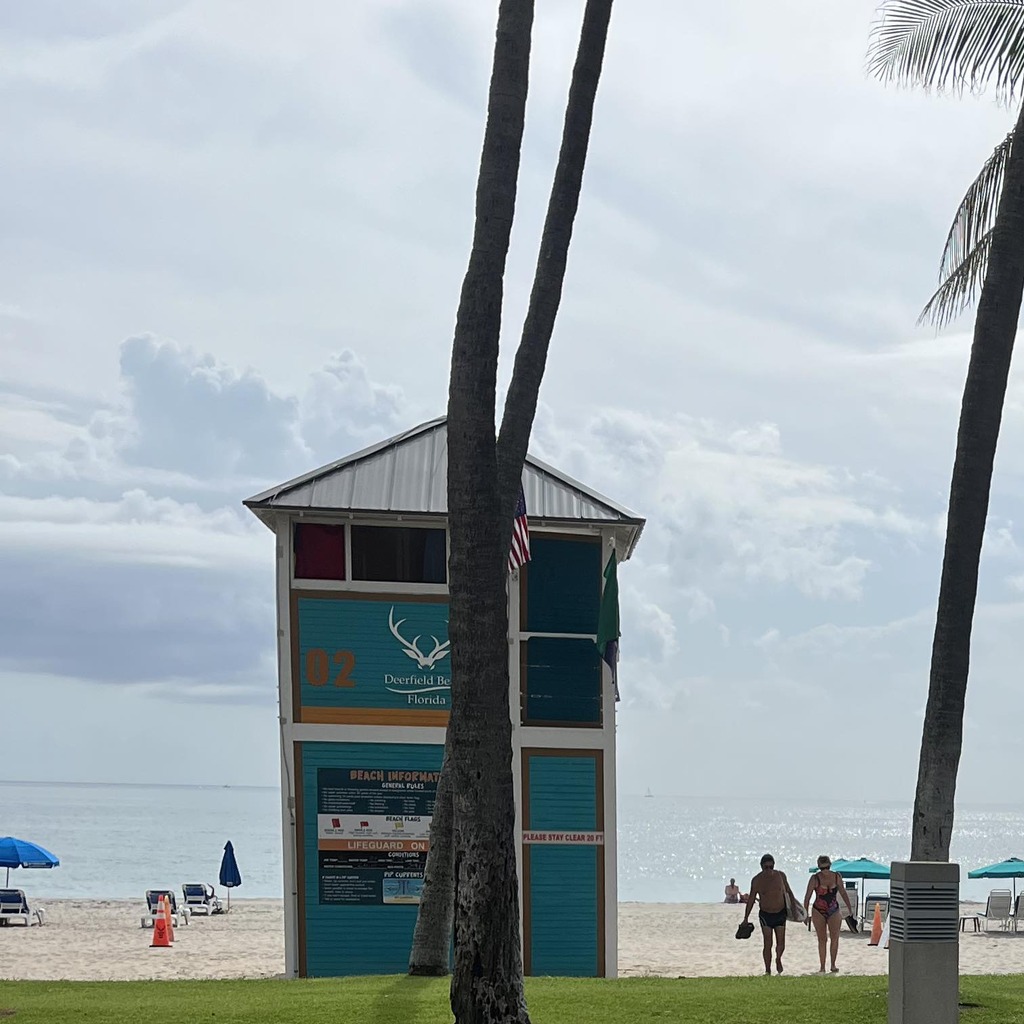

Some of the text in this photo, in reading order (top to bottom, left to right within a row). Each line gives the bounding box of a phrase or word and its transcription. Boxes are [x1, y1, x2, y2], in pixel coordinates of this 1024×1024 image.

[306, 648, 356, 688] 02
[384, 674, 434, 685] Deerfield
[407, 694, 446, 705] Florida
[350, 770, 384, 782] BEACH
[381, 782, 425, 790] GENERAL RULES
[523, 833, 547, 841] PLEASE
[564, 834, 586, 842] CLEAR
[586, 834, 594, 842] 20
[595, 834, 604, 842] FT
[347, 841, 425, 851] LIFEGUARD ON
[388, 851, 420, 859] CONDITIONS
[395, 871, 424, 879] CURRENTS
